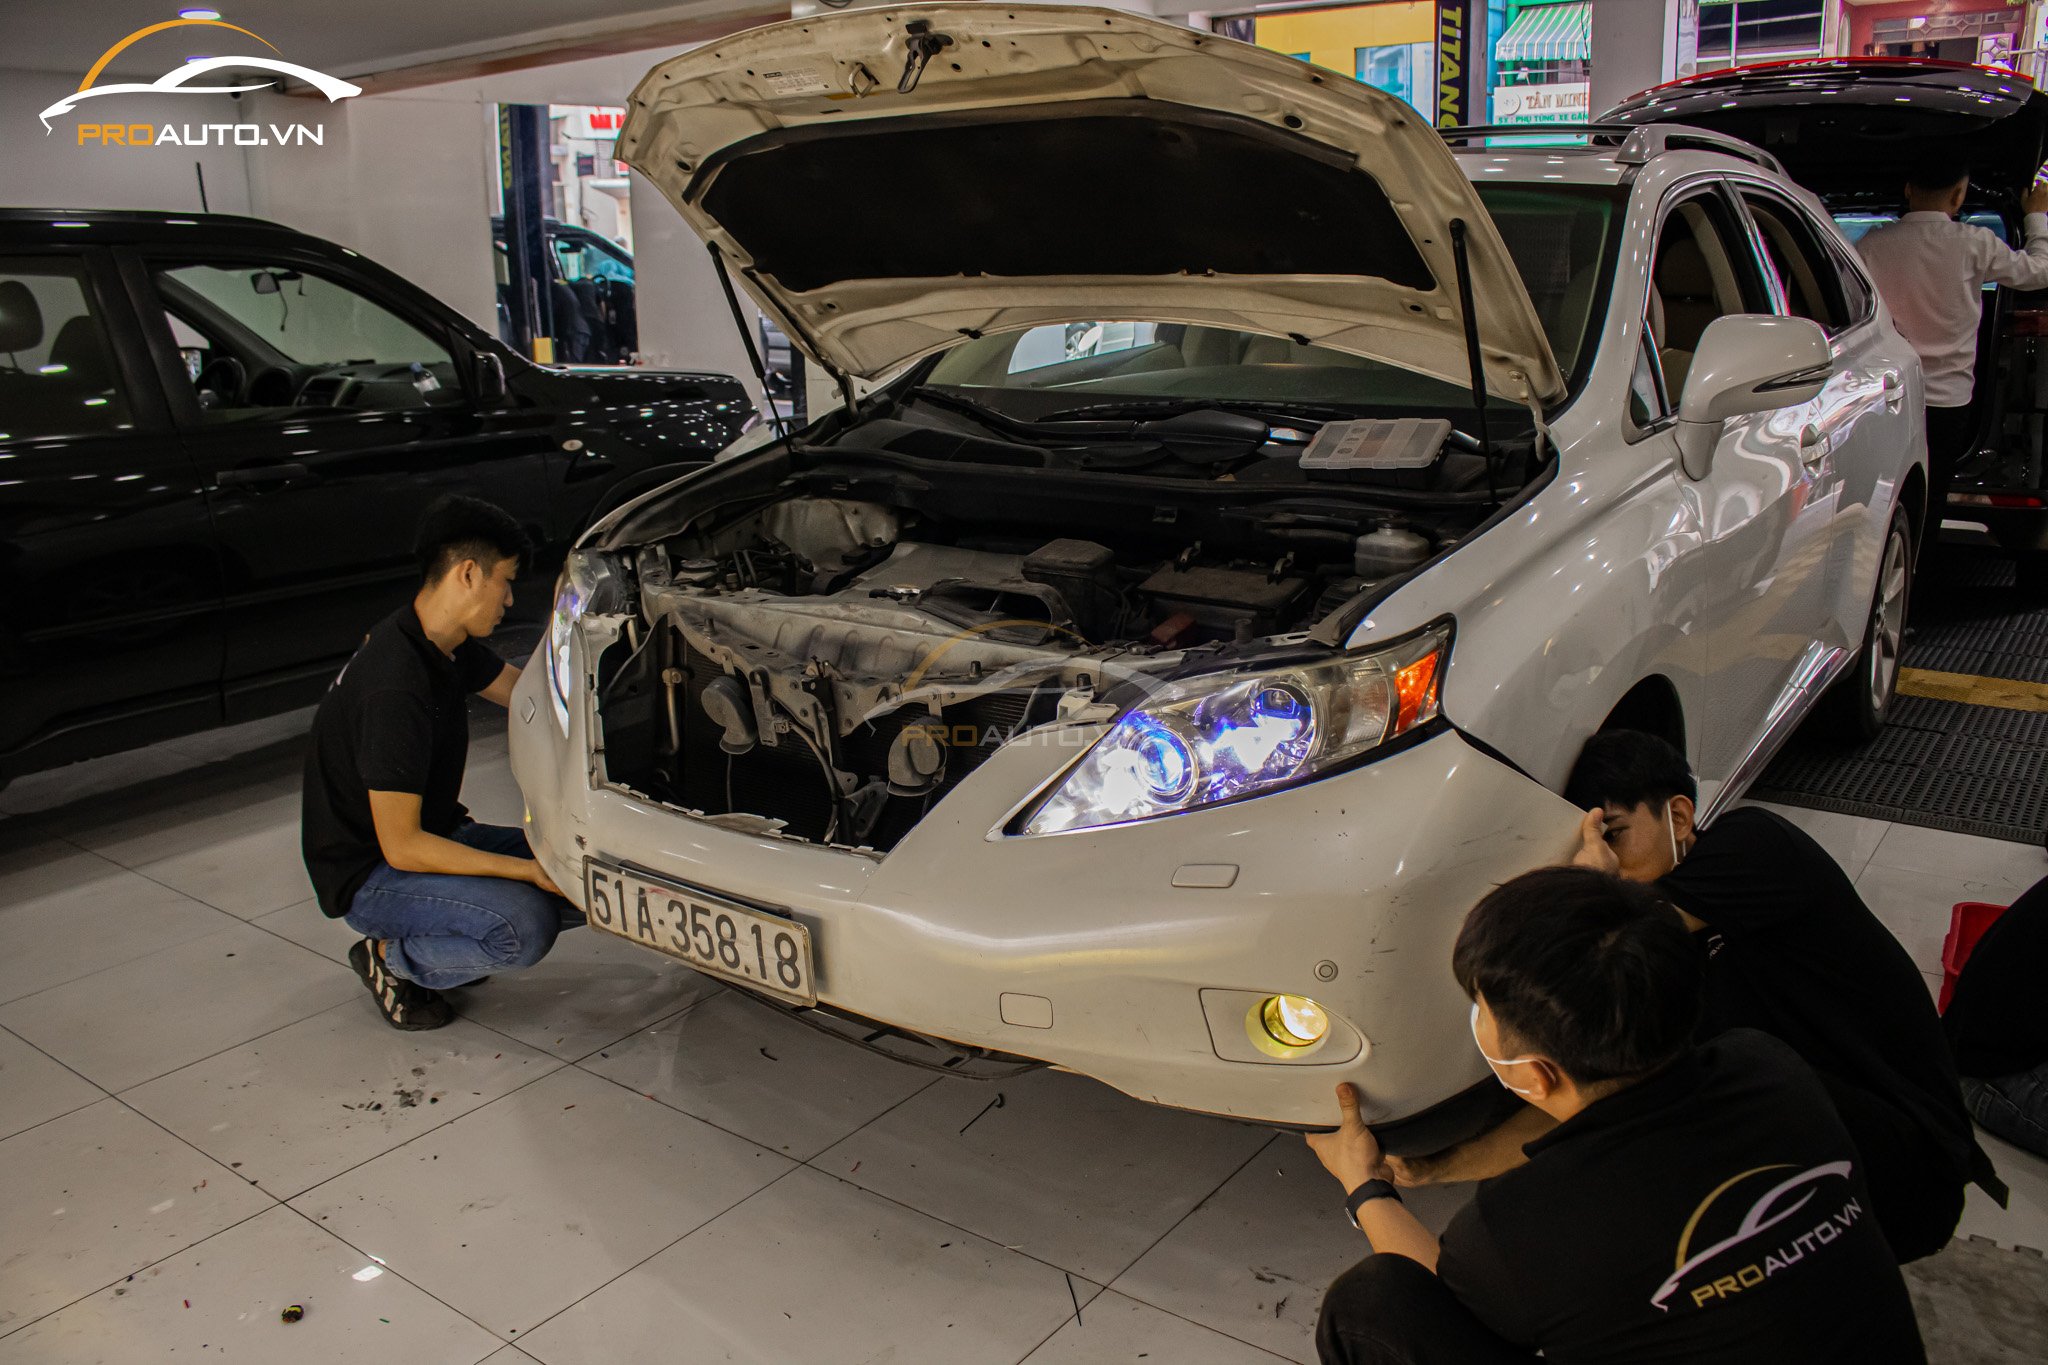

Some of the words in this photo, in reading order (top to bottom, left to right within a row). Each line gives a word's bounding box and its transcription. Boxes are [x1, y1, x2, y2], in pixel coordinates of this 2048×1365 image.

[1526, 91, 1552, 109] TÂN
[1559, 112, 1569, 121] XE
[1690, 1197, 1863, 1308] PROAUTO.VN
